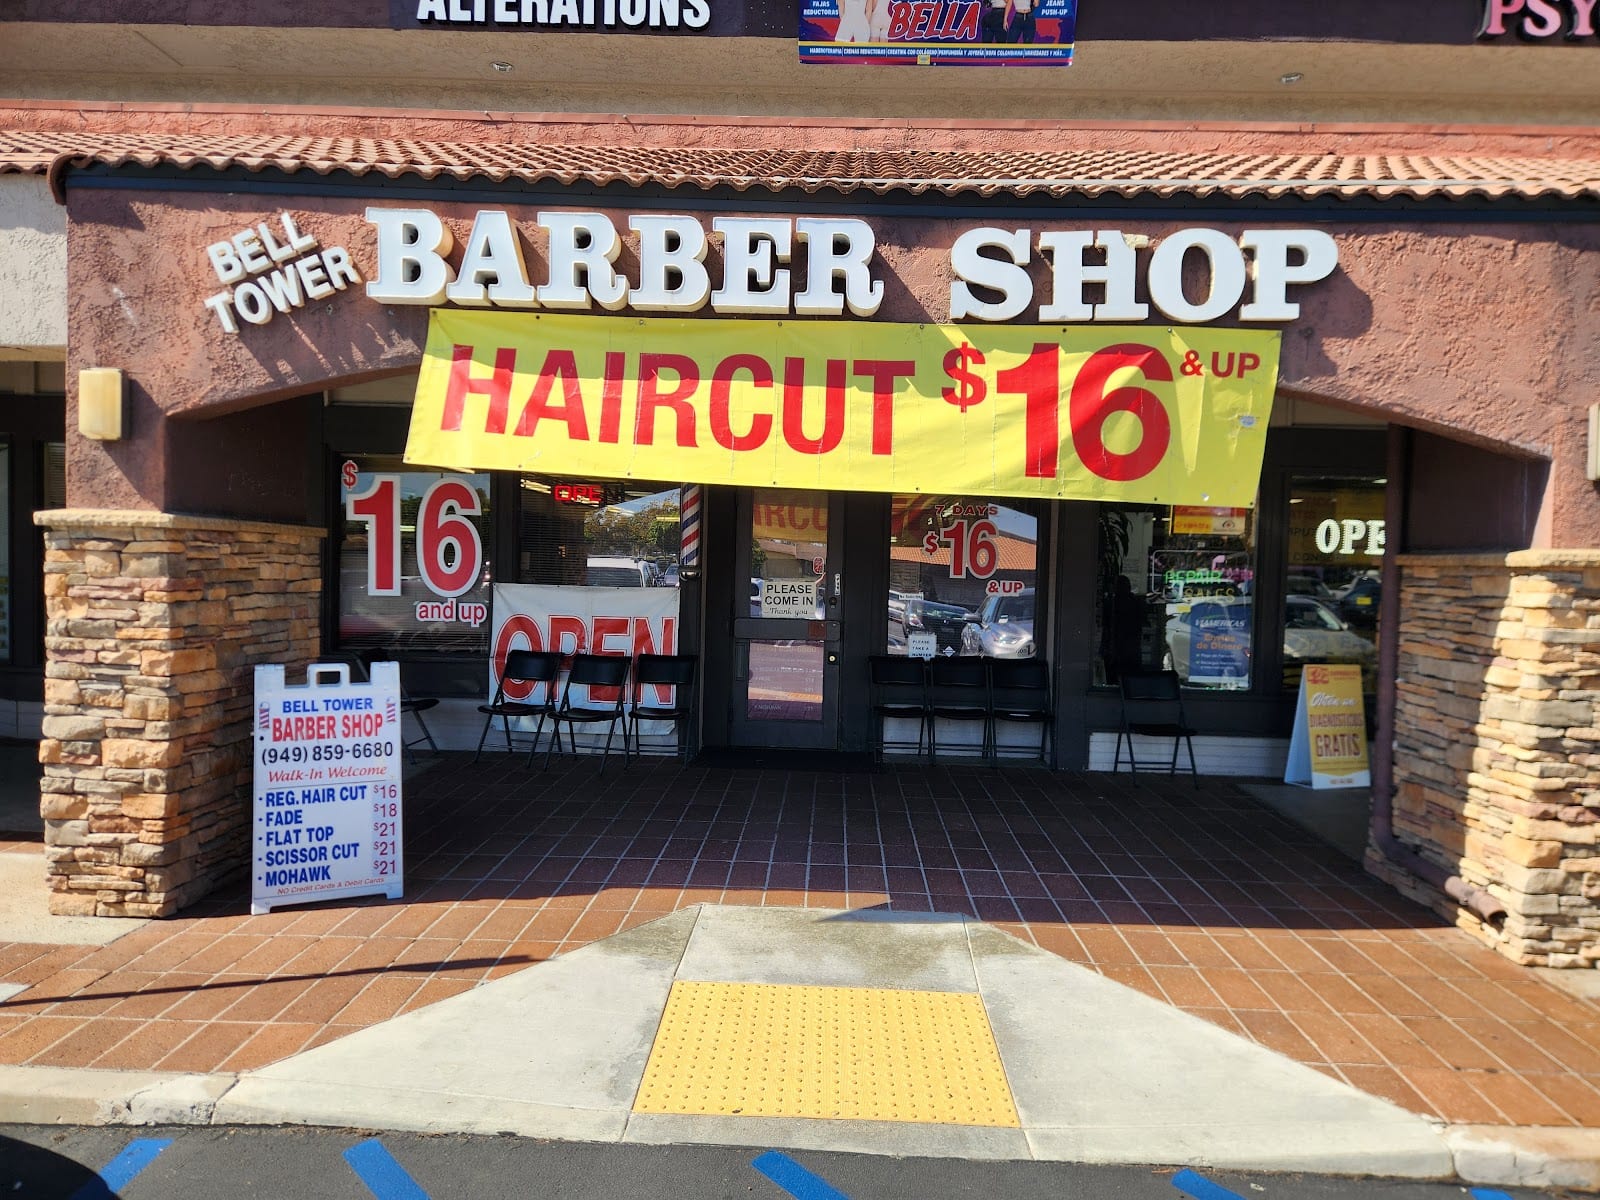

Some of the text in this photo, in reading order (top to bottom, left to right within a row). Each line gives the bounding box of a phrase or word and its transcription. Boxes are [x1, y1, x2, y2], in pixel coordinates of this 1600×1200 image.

[416, 0, 710, 27] ALTERATIONS
[888, 2, 979, 40] BELLA
[1485, 0, 1596, 36] PSY
[207, 211, 318, 285] BELL
[366, 207, 1339, 322] BARBER SHOP
[203, 246, 363, 334] TOWER
[440, 341, 1260, 482] HAIRCUT $16 & UP
[935, 505, 999, 516] 7 DAYS
[342, 460, 482, 598] $16
[923, 519, 1000, 579] $16
[764, 595, 814, 606] COME IN
[766, 584, 812, 594] PLEASE
[986, 581, 1024, 594] & UP
[417, 599, 486, 625] and up
[769, 607, 808, 617] Thank you
[494, 614, 677, 705] OPEN
[282, 698, 374, 713] BELL TOWER
[272, 713, 383, 742] BARBER SHOP
[262, 741, 393, 766] (949) 859-6680
[1315, 732, 1361, 757] GRATIS
[268, 766, 388, 783] Walk-In Welcome
[266, 784, 397, 807] REG. HAIR CUT $16
[266, 803, 397, 827] FADE $18
[266, 822, 396, 847] FLAT TOP $21
[265, 841, 396, 867] SCISSOR CUT $21
[265, 860, 396, 887] MOHAWK $21
[291, 885, 313, 893] Credit
[314, 883, 336, 891] Cards
